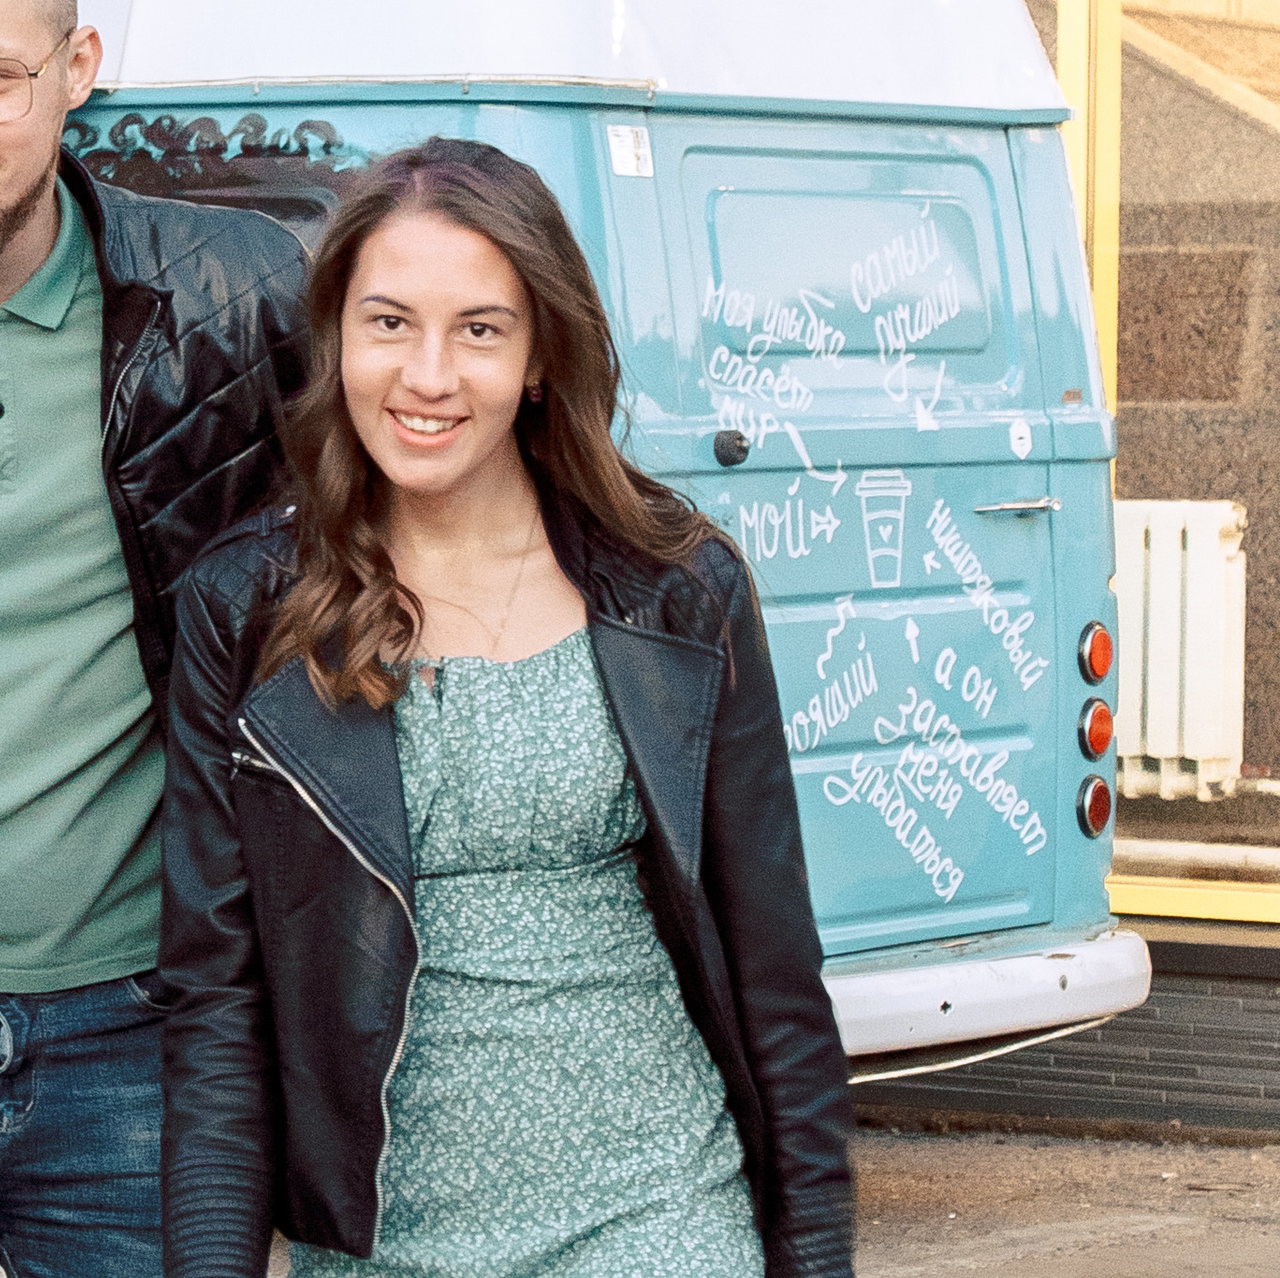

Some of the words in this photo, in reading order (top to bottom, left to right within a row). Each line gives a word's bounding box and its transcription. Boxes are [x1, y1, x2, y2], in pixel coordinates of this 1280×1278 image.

[851, 201, 941, 313] самый
[747, 289, 846, 369] улыбка
[962, 666, 999, 718] он
[874, 686, 1048, 855] заставляет
[824, 753, 964, 903] улыбаться
